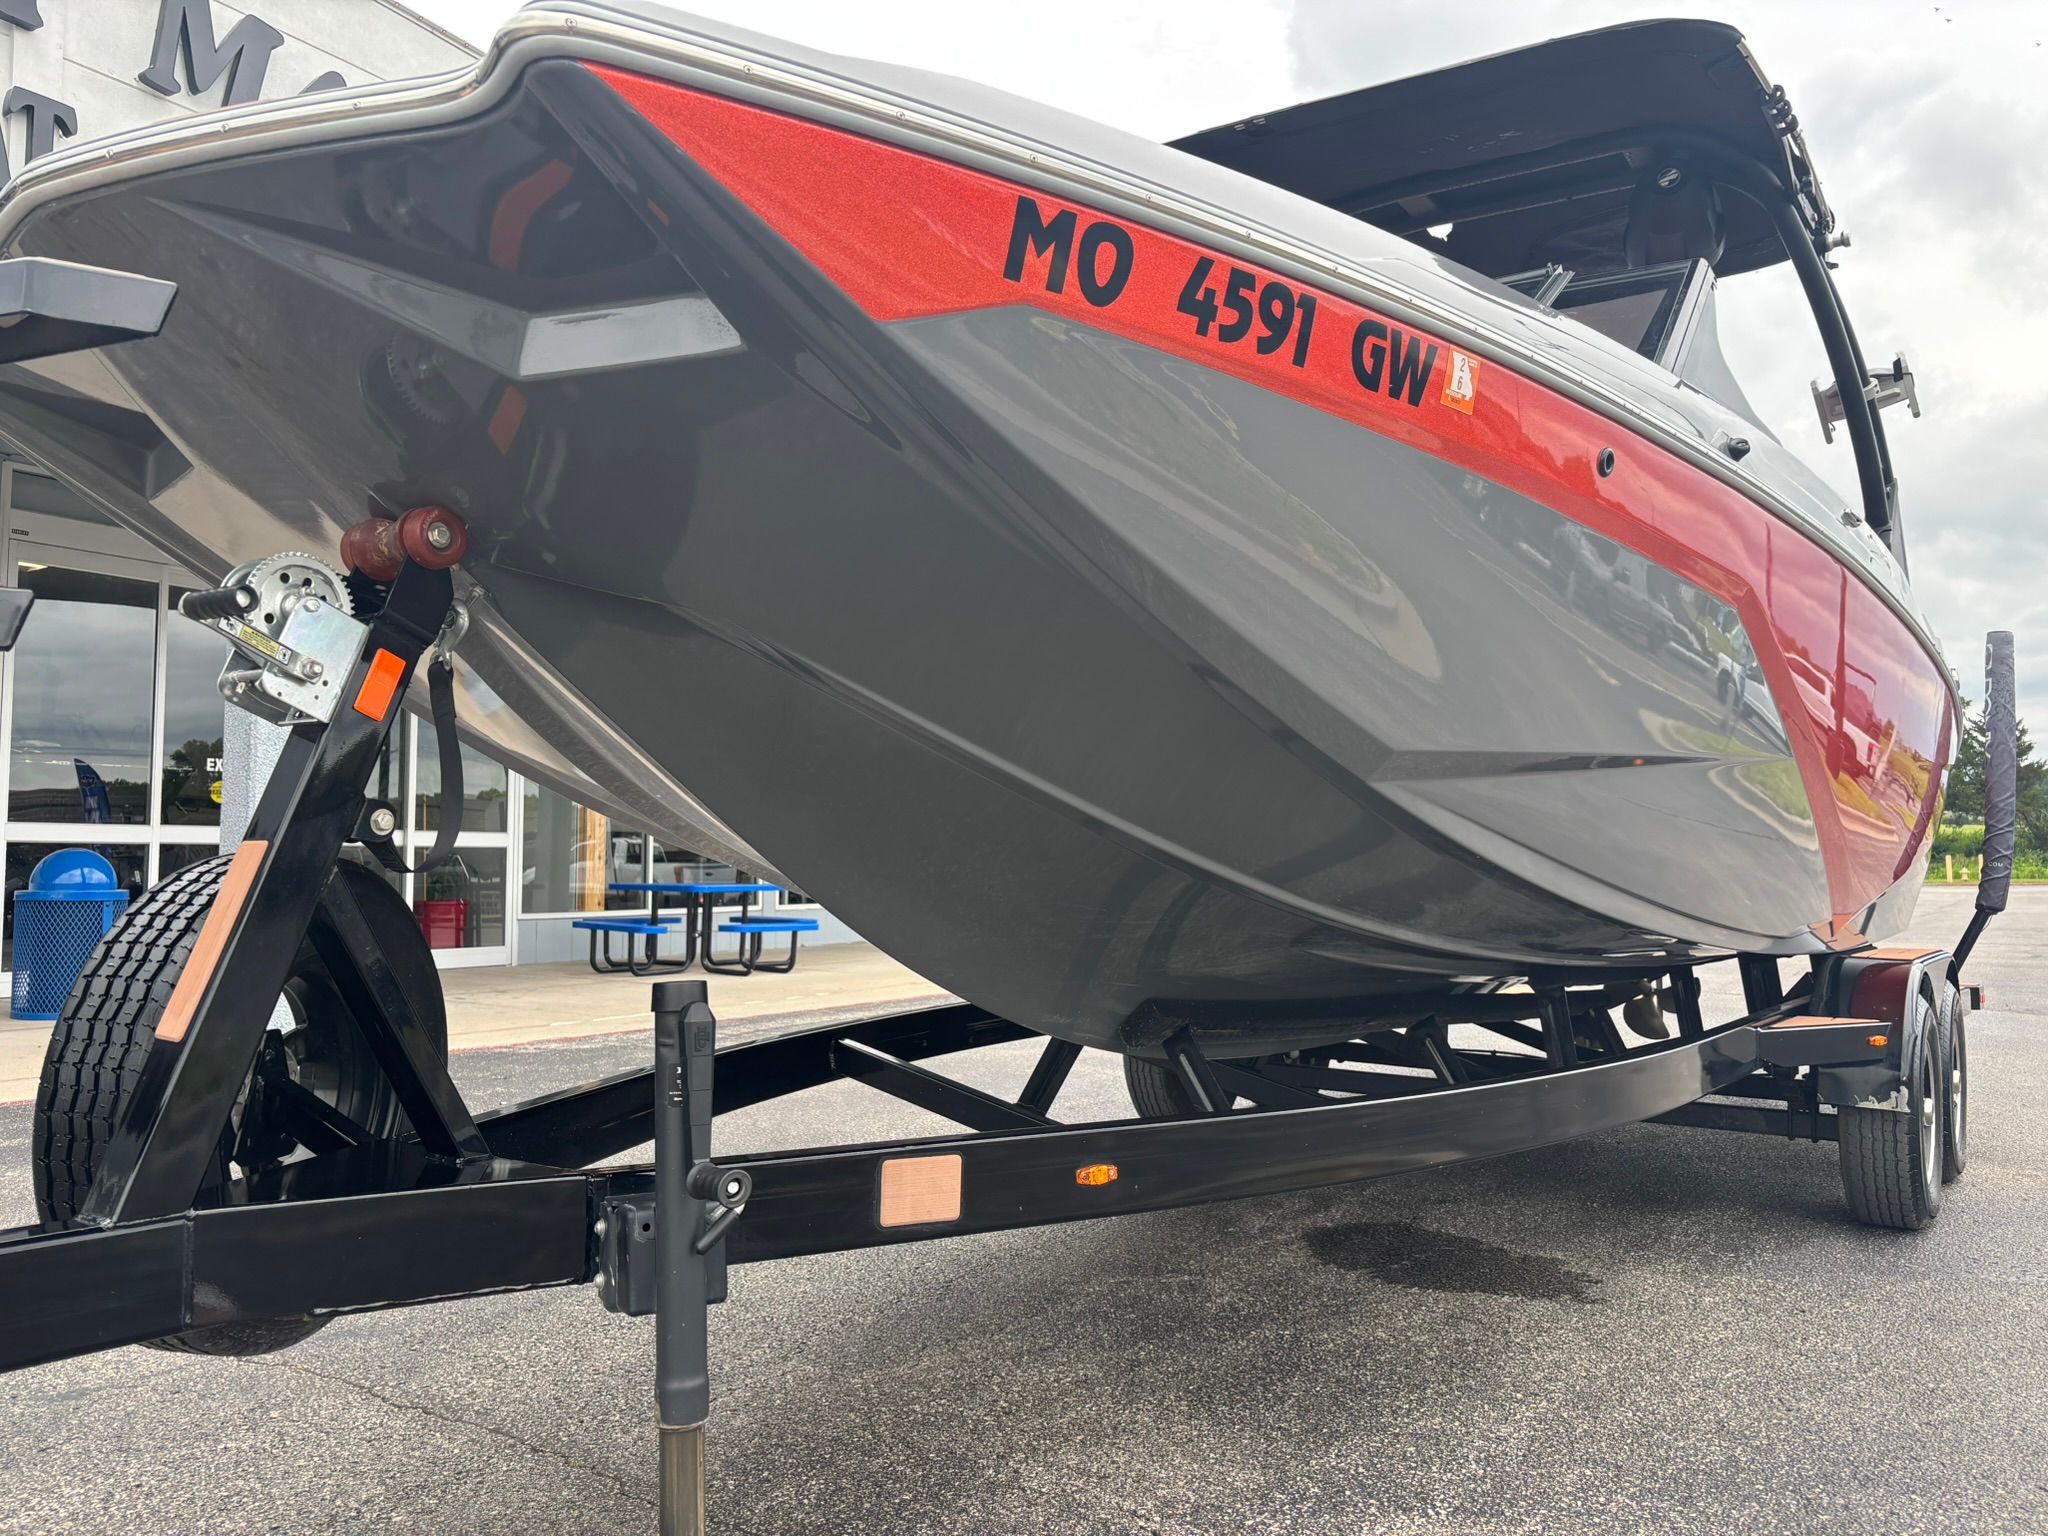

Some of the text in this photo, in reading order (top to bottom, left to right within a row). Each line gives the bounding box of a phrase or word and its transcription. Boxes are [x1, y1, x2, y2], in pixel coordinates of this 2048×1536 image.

[1003, 196, 1438, 407] MO 4591 GW
